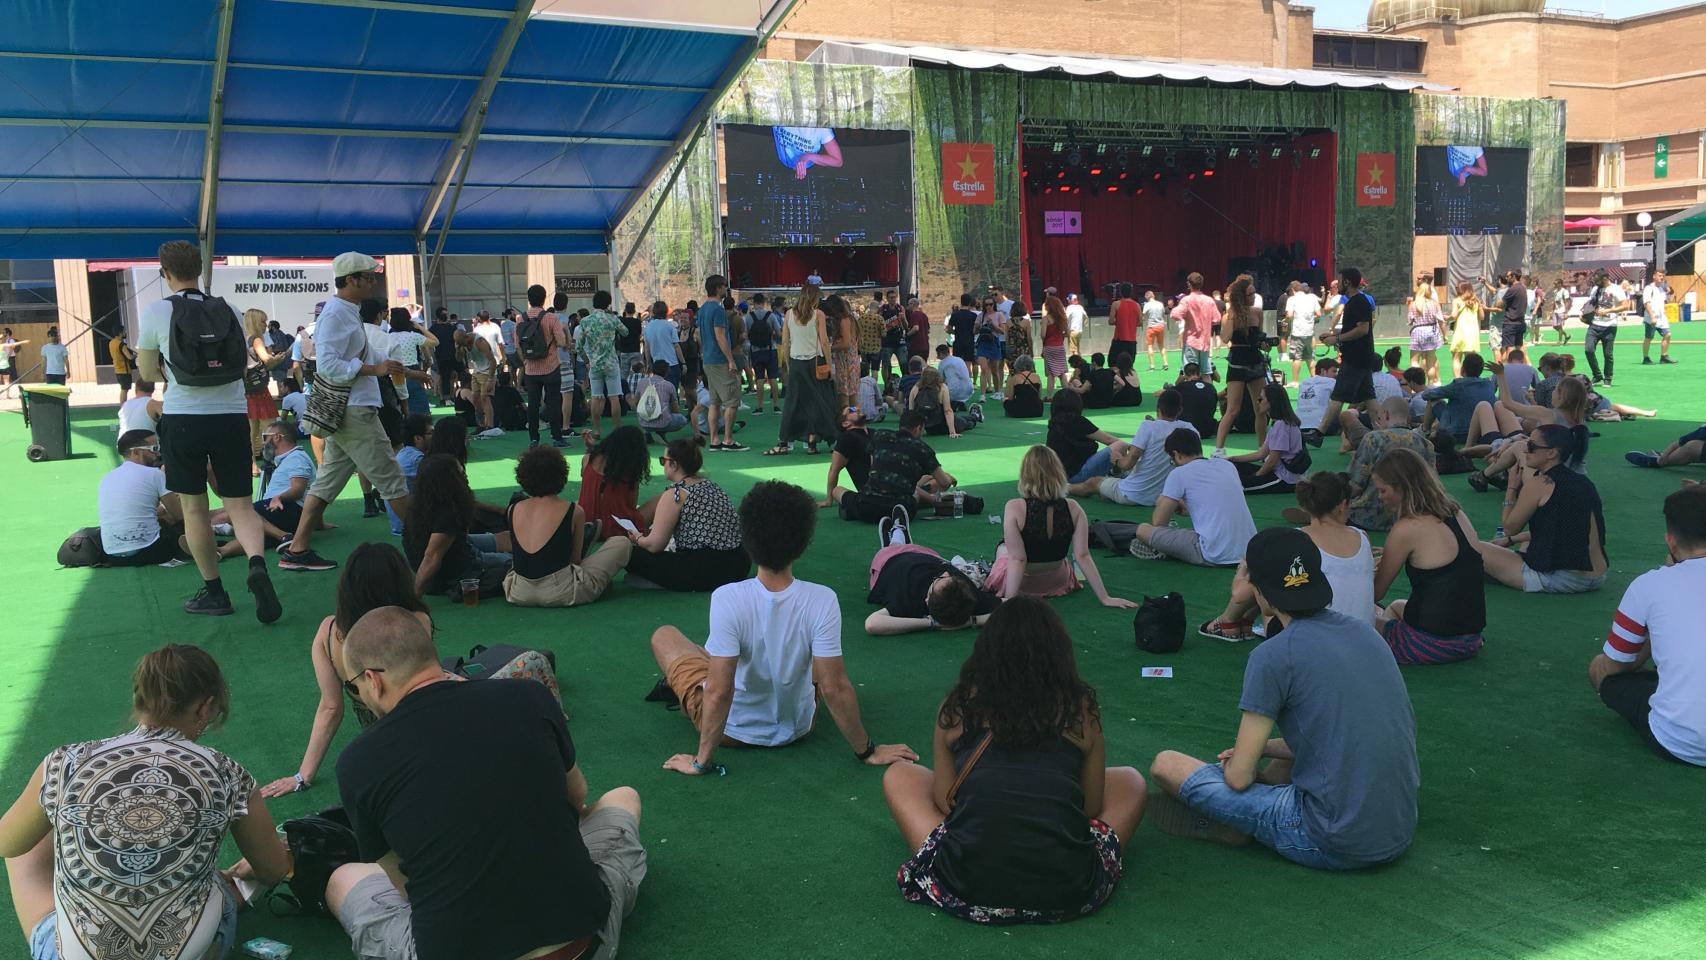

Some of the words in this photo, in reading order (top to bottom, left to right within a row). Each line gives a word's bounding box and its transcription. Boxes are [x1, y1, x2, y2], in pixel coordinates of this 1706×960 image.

[953, 180, 985, 192] Estrella
[257, 269, 307, 280] ABSOLUT.
[235, 283, 260, 293] NEW
[262, 282, 329, 293] DIMENSIONS
[561, 278, 591, 289] Pausa
